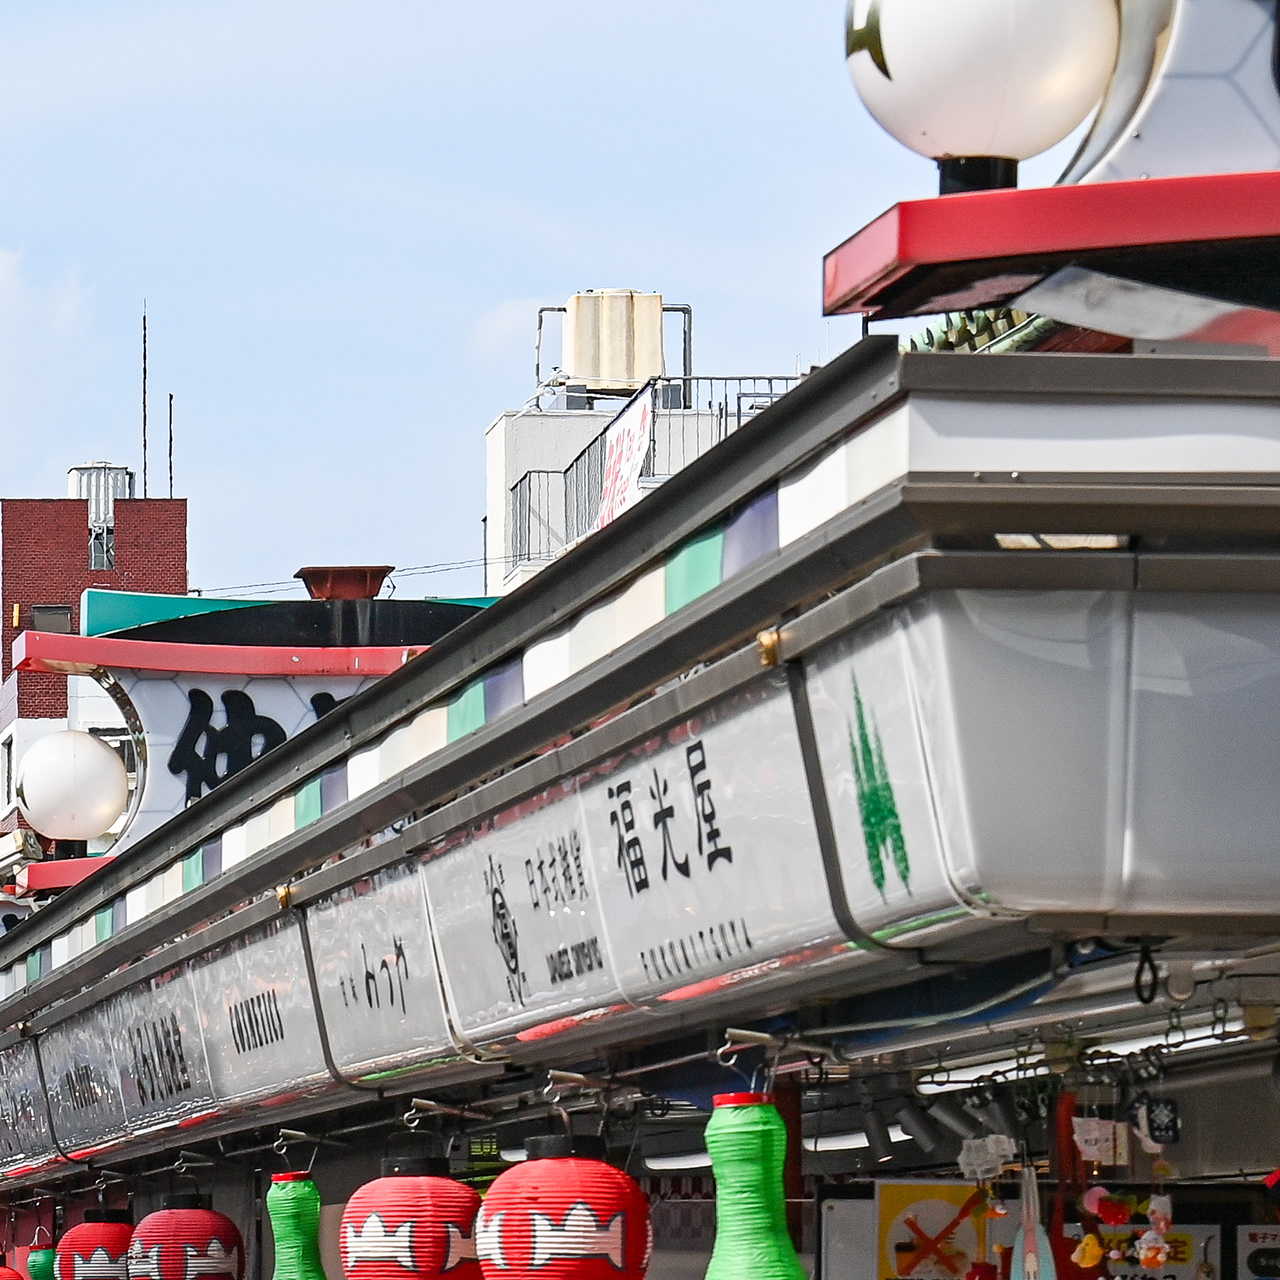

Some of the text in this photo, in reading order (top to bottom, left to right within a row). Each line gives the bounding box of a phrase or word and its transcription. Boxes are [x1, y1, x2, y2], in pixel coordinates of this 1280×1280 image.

[607, 739, 733, 899] 福光屋
[228, 987, 285, 1055] COSMETICS
